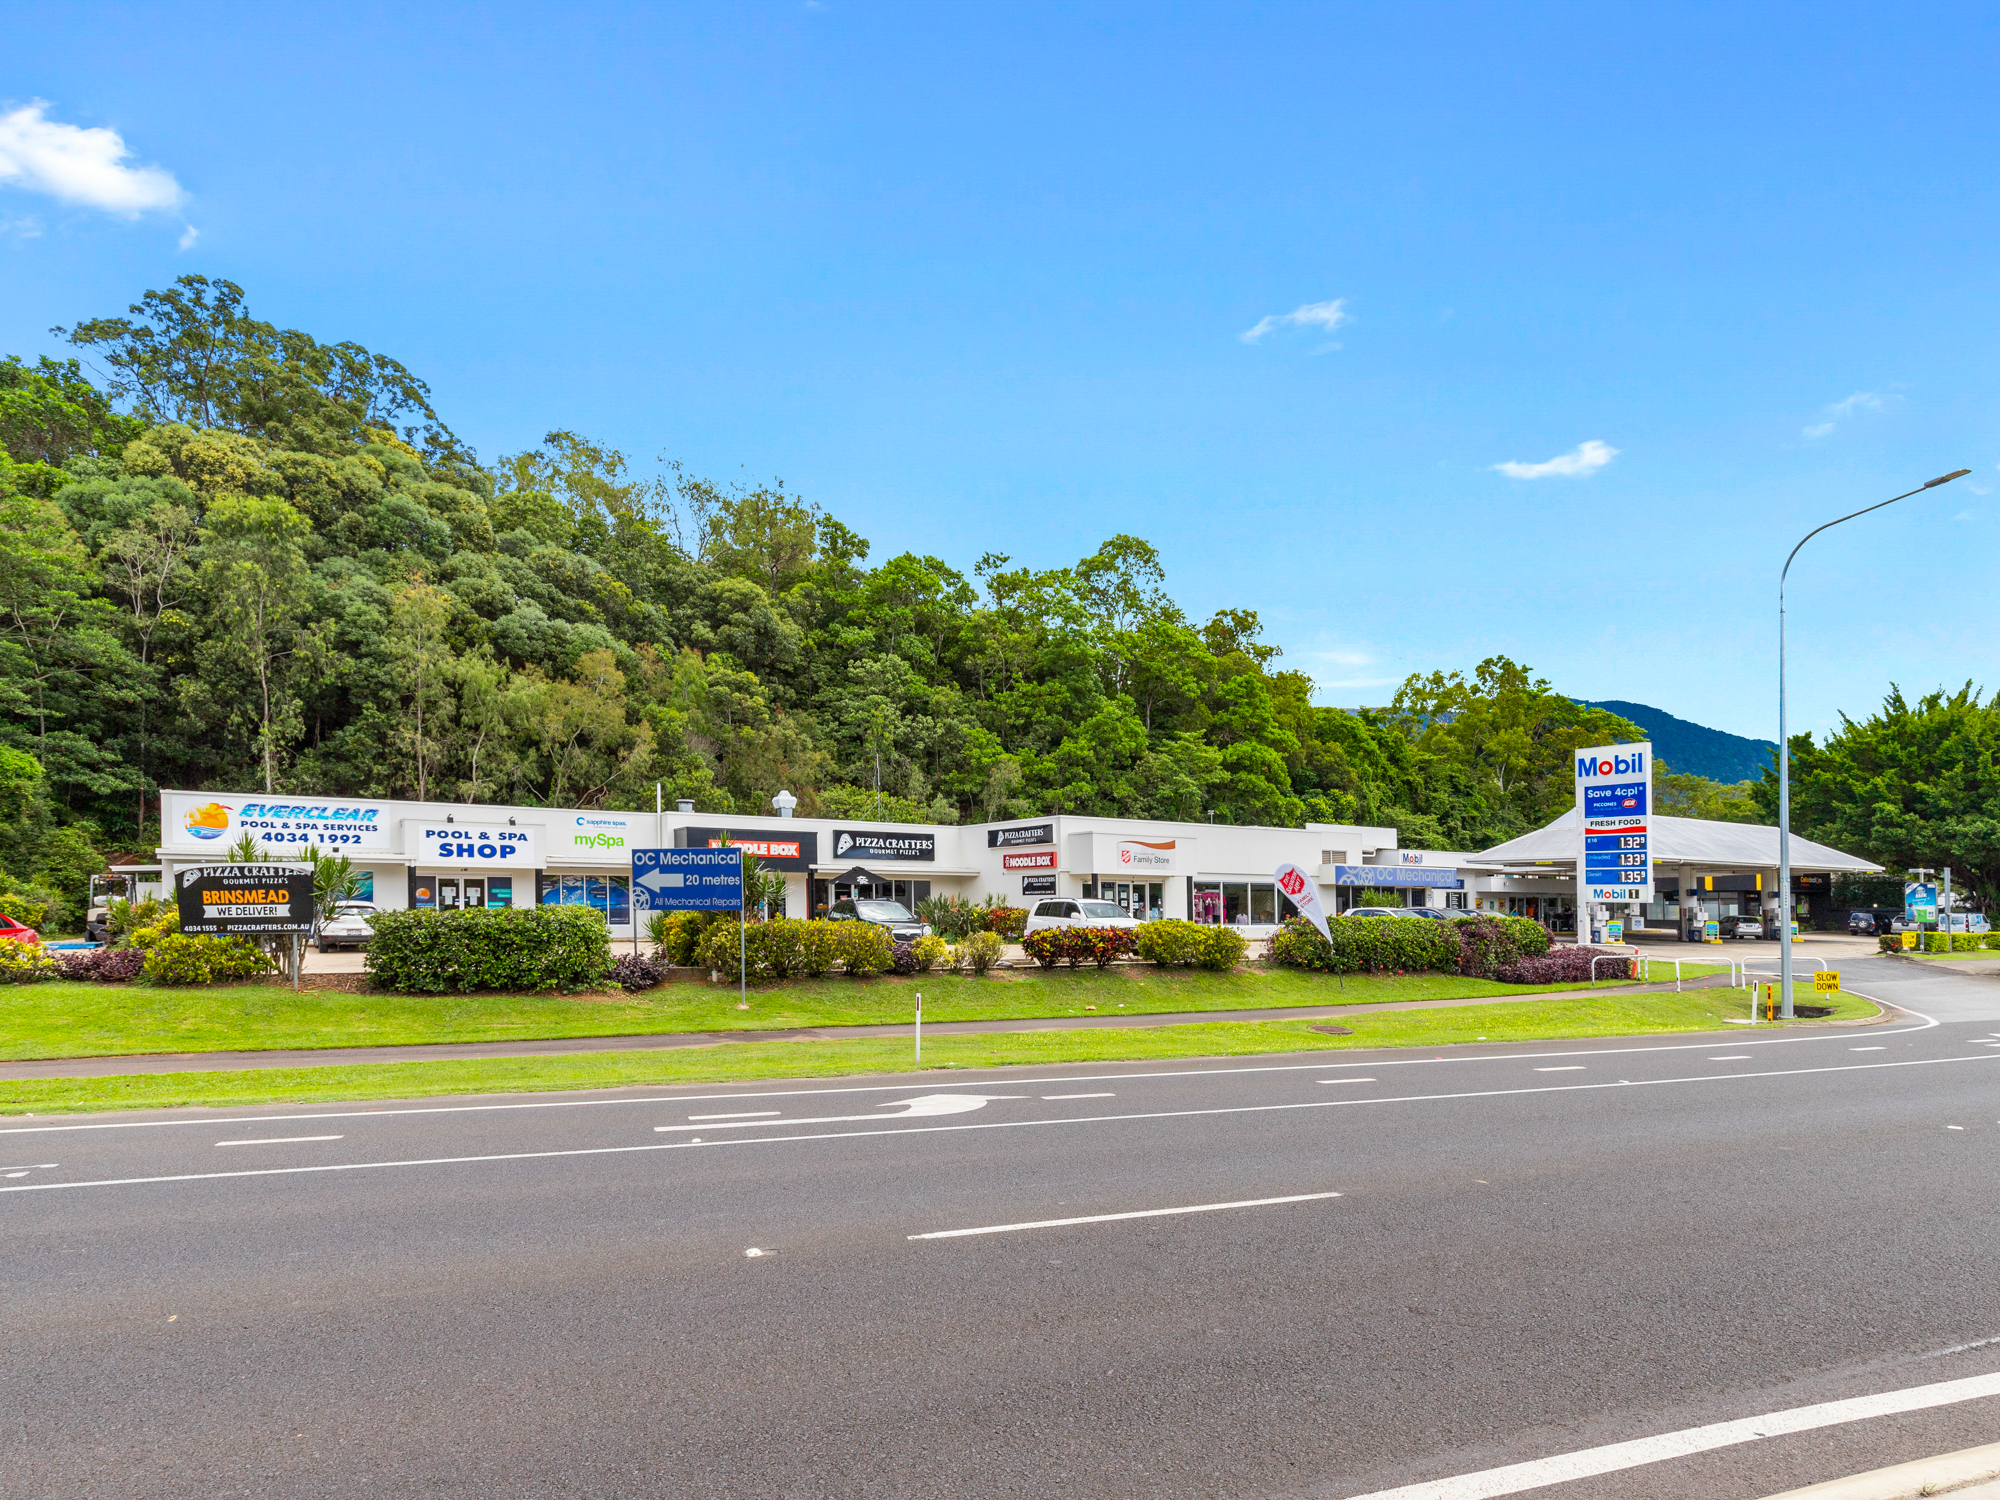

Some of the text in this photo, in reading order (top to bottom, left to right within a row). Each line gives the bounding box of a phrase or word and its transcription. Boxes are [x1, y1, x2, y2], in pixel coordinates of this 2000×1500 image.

[1578, 753, 1642, 777] Mobil
[1587, 789, 1611, 798] Save
[239, 803, 379, 822] EVERCLEAR
[240, 820, 277, 829] POOL
[295, 823, 319, 831] SPA
[323, 824, 378, 832] SERVICES
[1618, 818, 1641, 826] FOOD
[261, 832, 362, 844] 4034 1992
[425, 829, 528, 842] POOL & SPA
[1004, 827, 1044, 840] PIZZA CRAFTERS
[574, 832, 625, 850] mySpa
[855, 836, 933, 850] PIZZA CRAFTERS
[438, 842, 516, 859] SHOP
[711, 841, 798, 856] NODLE BOX
[633, 851, 740, 866] OC Mechanical
[1009, 855, 1051, 868] NOODLE BOX
[1133, 855, 1170, 865] Family Store
[1402, 853, 1423, 863] Mobil
[203, 866, 241, 877] PIZZA
[1376, 868, 1455, 882] OC Mechanical
[262, 876, 289, 884] PIZZA'S
[685, 874, 741, 886] 20 metres
[202, 889, 290, 905] BRINSMEAD
[1297, 892, 1312, 905] FAMILY
[1593, 889, 1626, 899] Mobil
[653, 897, 741, 908] All Mechanical Repairs
[1300, 897, 1314, 909] STORE
[217, 906, 278, 916] WE DELIVER!
[227, 923, 310, 931] PIZZACRAFTERS.COM.AU
[1816, 973, 1838, 982] SLOW
[1816, 982, 1838, 991] DOWN
